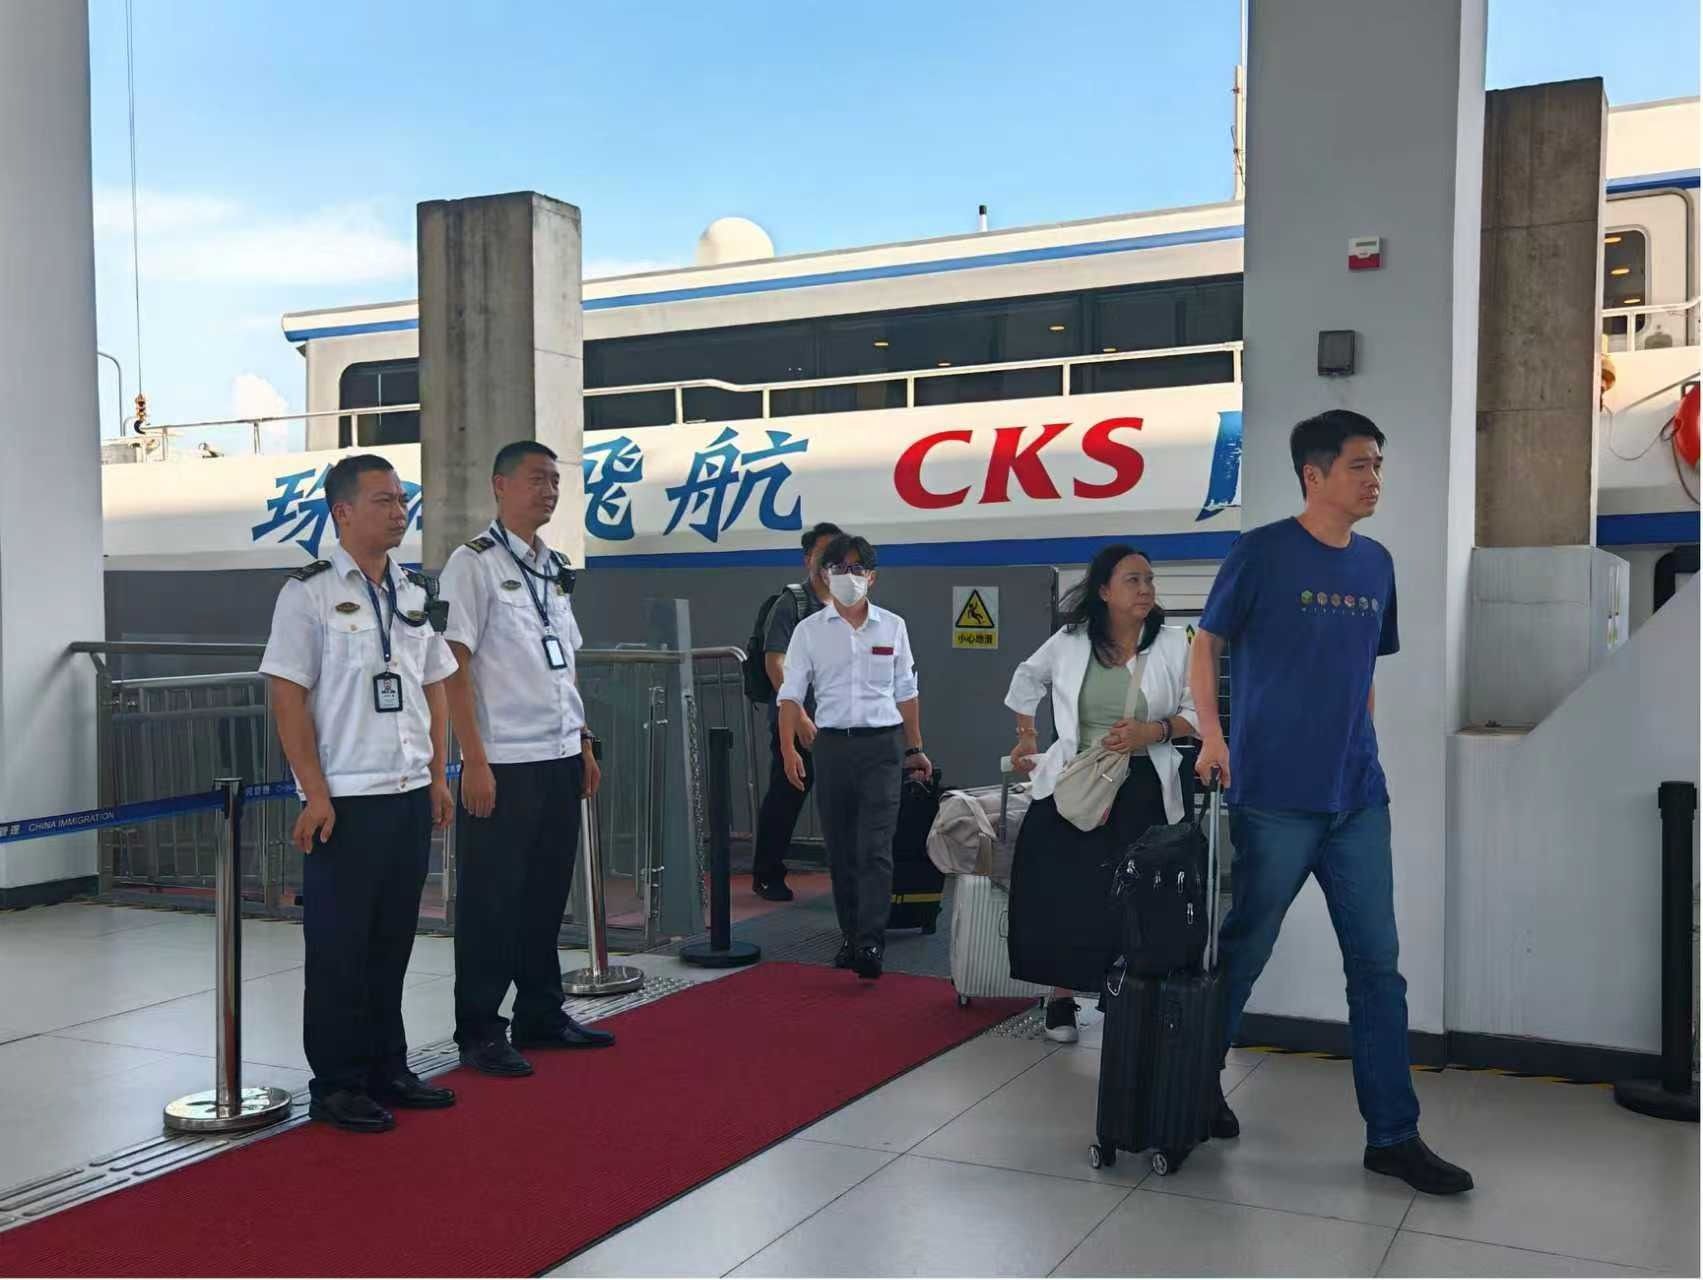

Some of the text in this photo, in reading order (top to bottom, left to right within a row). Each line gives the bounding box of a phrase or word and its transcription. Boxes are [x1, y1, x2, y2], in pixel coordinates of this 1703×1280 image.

[894, 417, 1144, 509] CKS
[957, 632, 993, 645] 小心地滑
[28, 820, 56, 832] CHINA
[58, 812, 114, 828] IMMIGRATION
